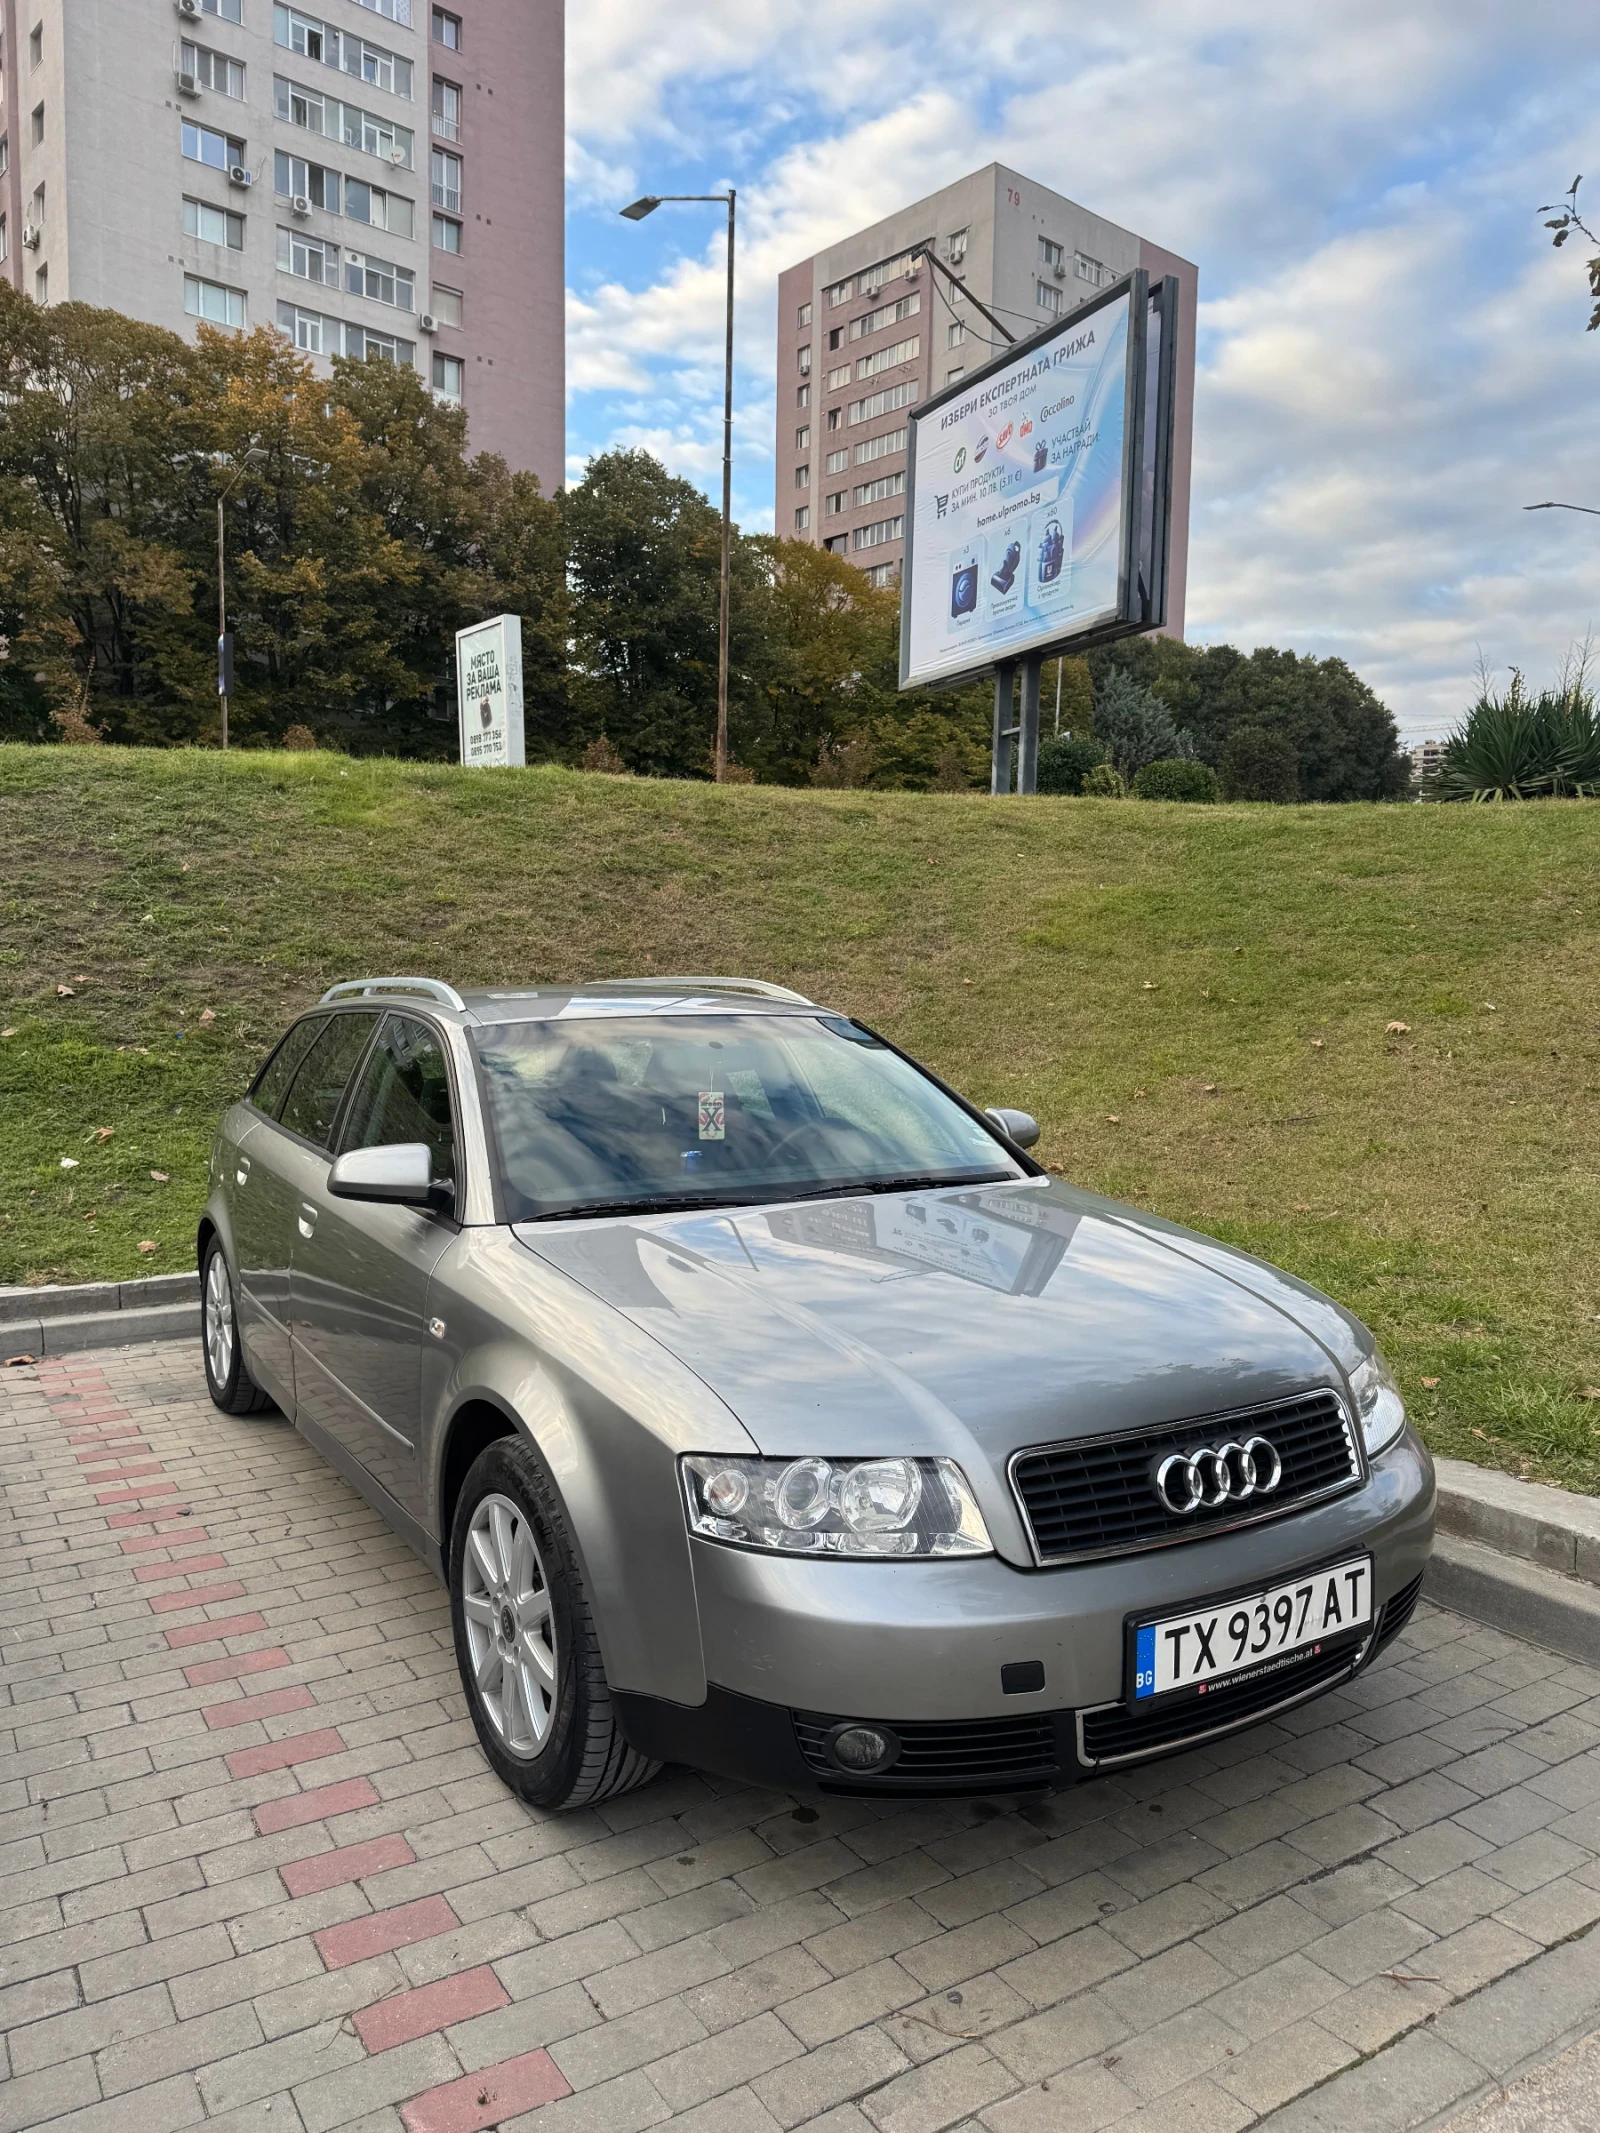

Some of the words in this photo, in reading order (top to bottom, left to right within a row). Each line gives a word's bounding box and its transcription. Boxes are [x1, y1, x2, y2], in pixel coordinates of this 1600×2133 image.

[1008, 188, 1020, 206] 79
[941, 398, 977, 431] ИЗБЕРИ
[979, 356, 1051, 409] ЕКСПЕРТНАТА
[1053, 330, 1096, 366] ГРИЖА
[1040, 395, 1075, 423] Coccolino
[1051, 418, 1091, 449] УЧАСТВАЙ
[1051, 452, 1061, 464] ЗА
[1062, 433, 1101, 461] НАГРАДИ:
[951, 483, 969, 500] КУПИ
[970, 464, 1005, 490] ПРОДУКТИ
[951, 503, 960, 513] ЗА
[961, 496, 978, 509] МИН.
[980, 487, 987, 498] 10
[976, 492, 1041, 528] home.ulpromo.bg
[471, 650, 494, 670] МЯСТО
[466, 673, 476, 686] ЗА
[478, 664, 500, 682] ВАША
[466, 681, 502, 702] РЕКЛАМА
[701, 1108, 722, 1132] X
[1164, 1618, 1218, 1680] TX
[1228, 1584, 1313, 1662] 9397
[1322, 1568, 1366, 1629] AT
[1136, 1670, 1152, 1689] BG
[1208, 1648, 1314, 1692] www.wienerstaedtische.at
